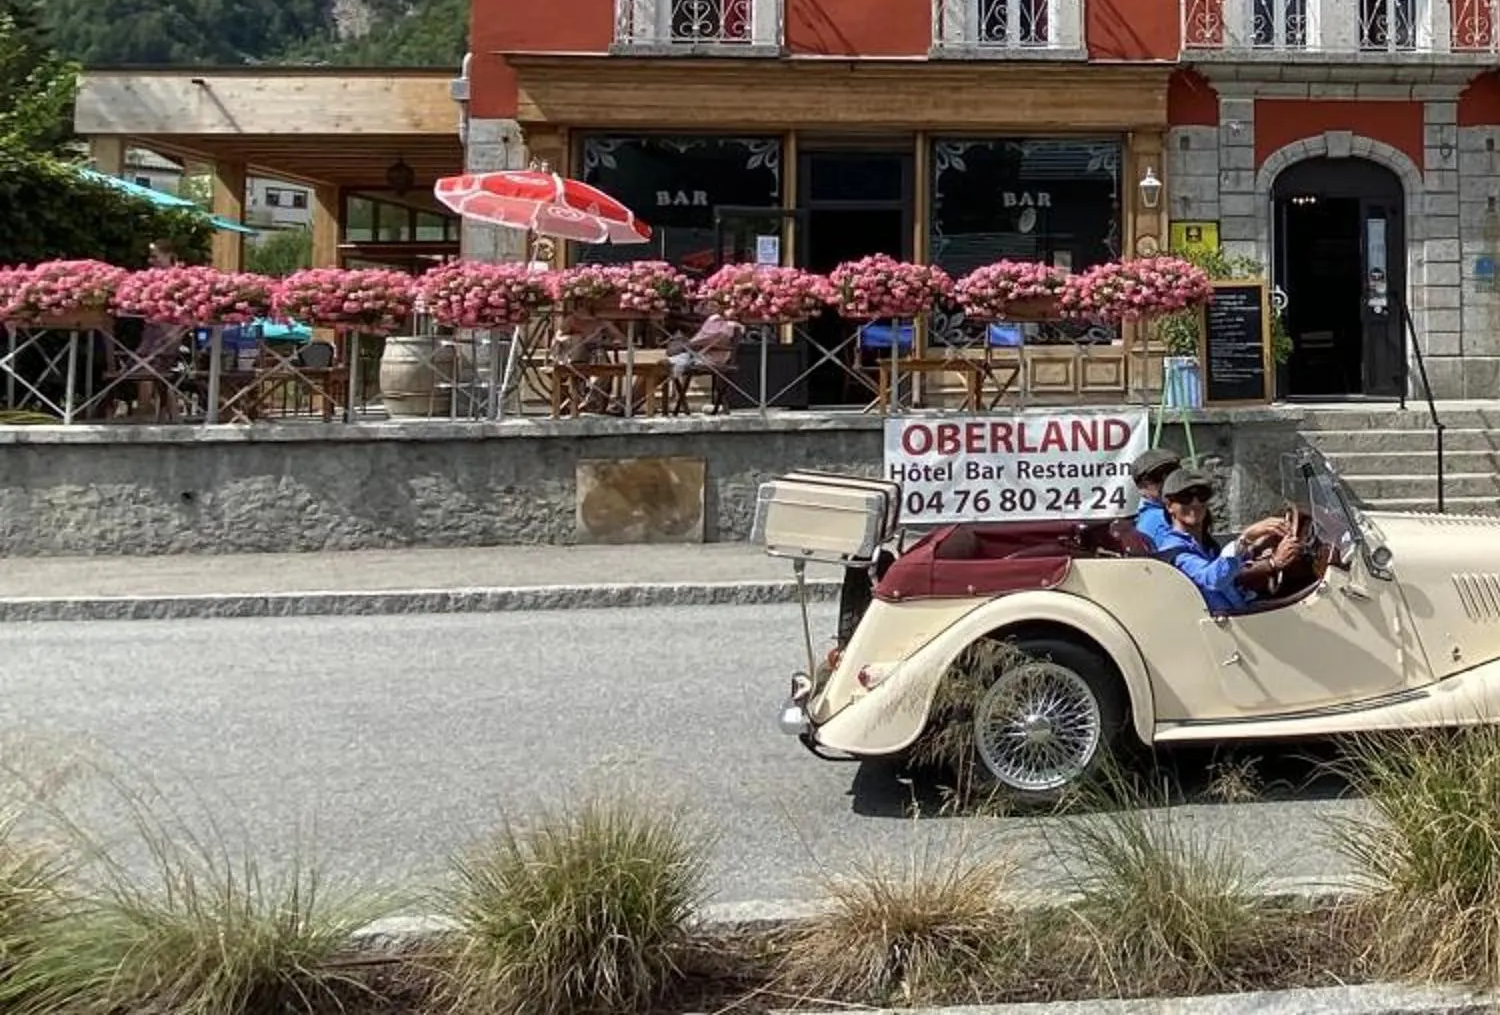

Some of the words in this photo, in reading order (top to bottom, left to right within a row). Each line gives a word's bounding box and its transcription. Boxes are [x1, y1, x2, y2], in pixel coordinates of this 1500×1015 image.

[656, 190, 708, 206] BAR
[1003, 191, 1052, 207] BAR
[902, 418, 1131, 455] OBERLAND
[890, 460, 953, 483] Hôtel
[966, 461, 1004, 481] Bar
[1017, 460, 1133, 480] Restauran
[906, 490, 945, 515] 04
[953, 489, 991, 514] 76
[1000, 487, 1037, 512] 80
[1045, 487, 1082, 511] 24
[1091, 485, 1127, 510] 24
